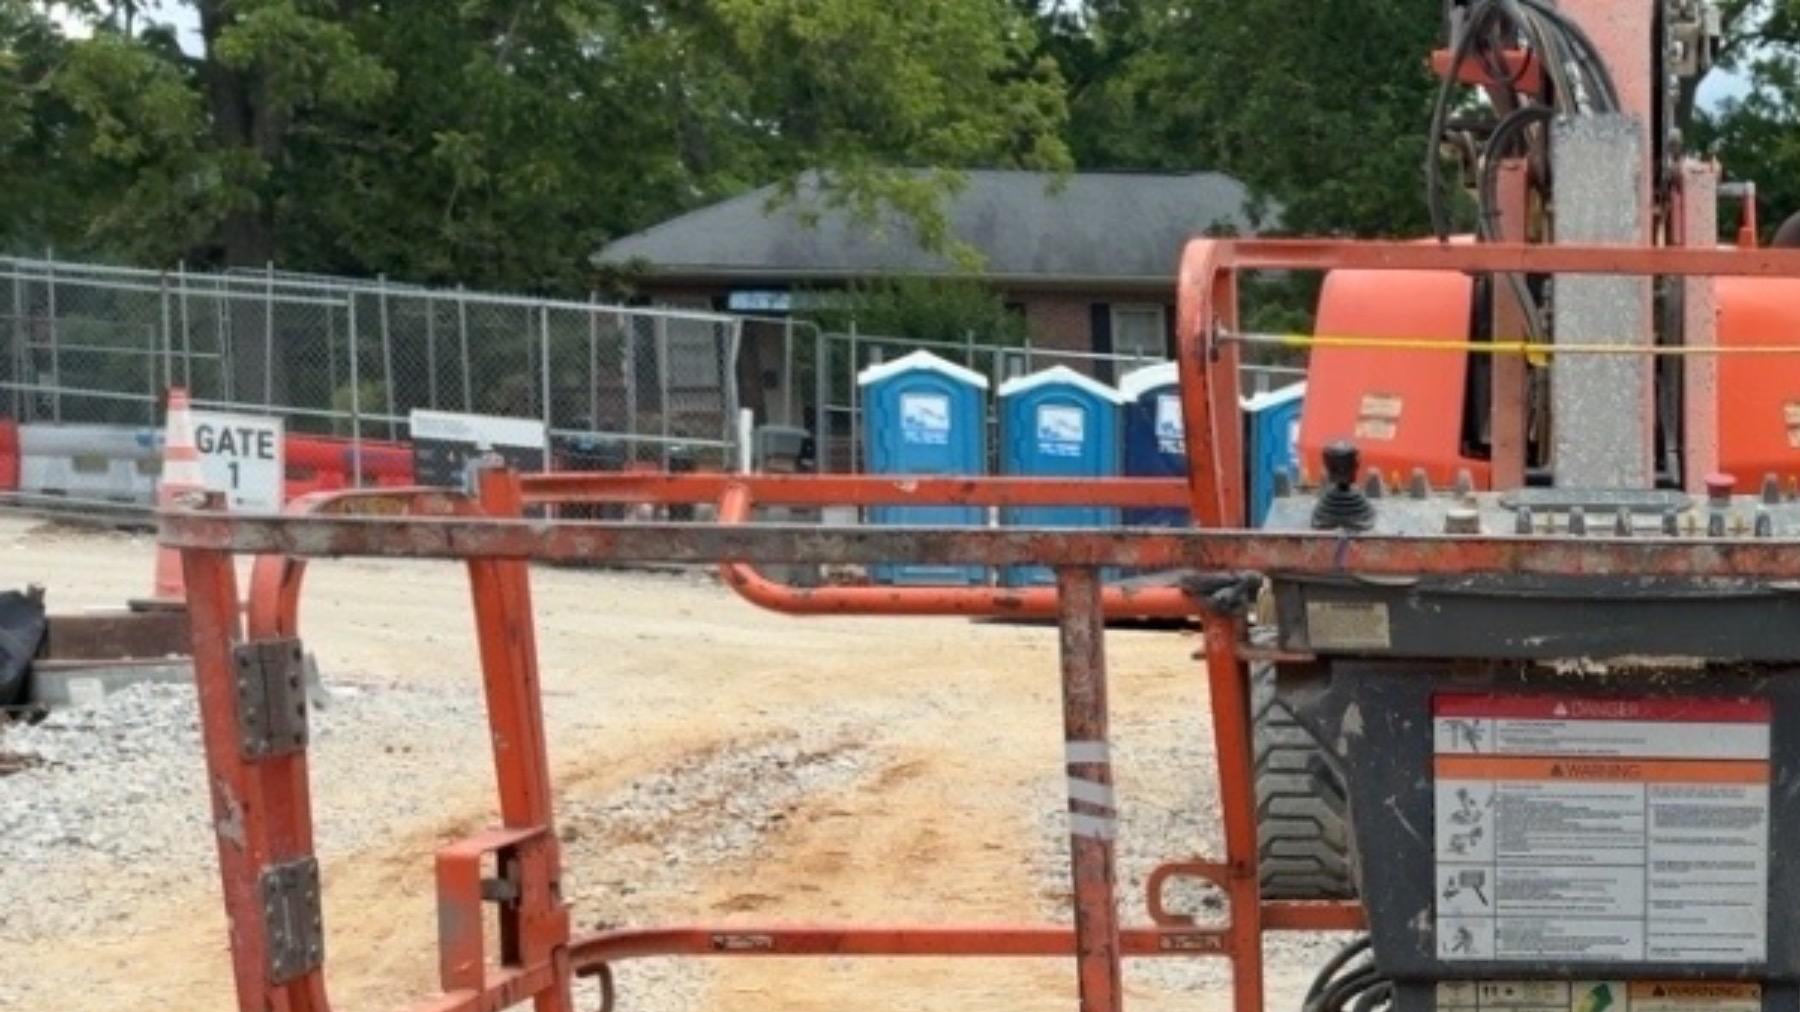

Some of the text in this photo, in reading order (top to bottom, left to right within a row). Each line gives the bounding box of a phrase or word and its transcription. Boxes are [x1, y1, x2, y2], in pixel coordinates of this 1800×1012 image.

[195, 424, 274, 459] GATE
[228, 461, 239, 489] 1
[1565, 763, 1641, 778] WARNING
